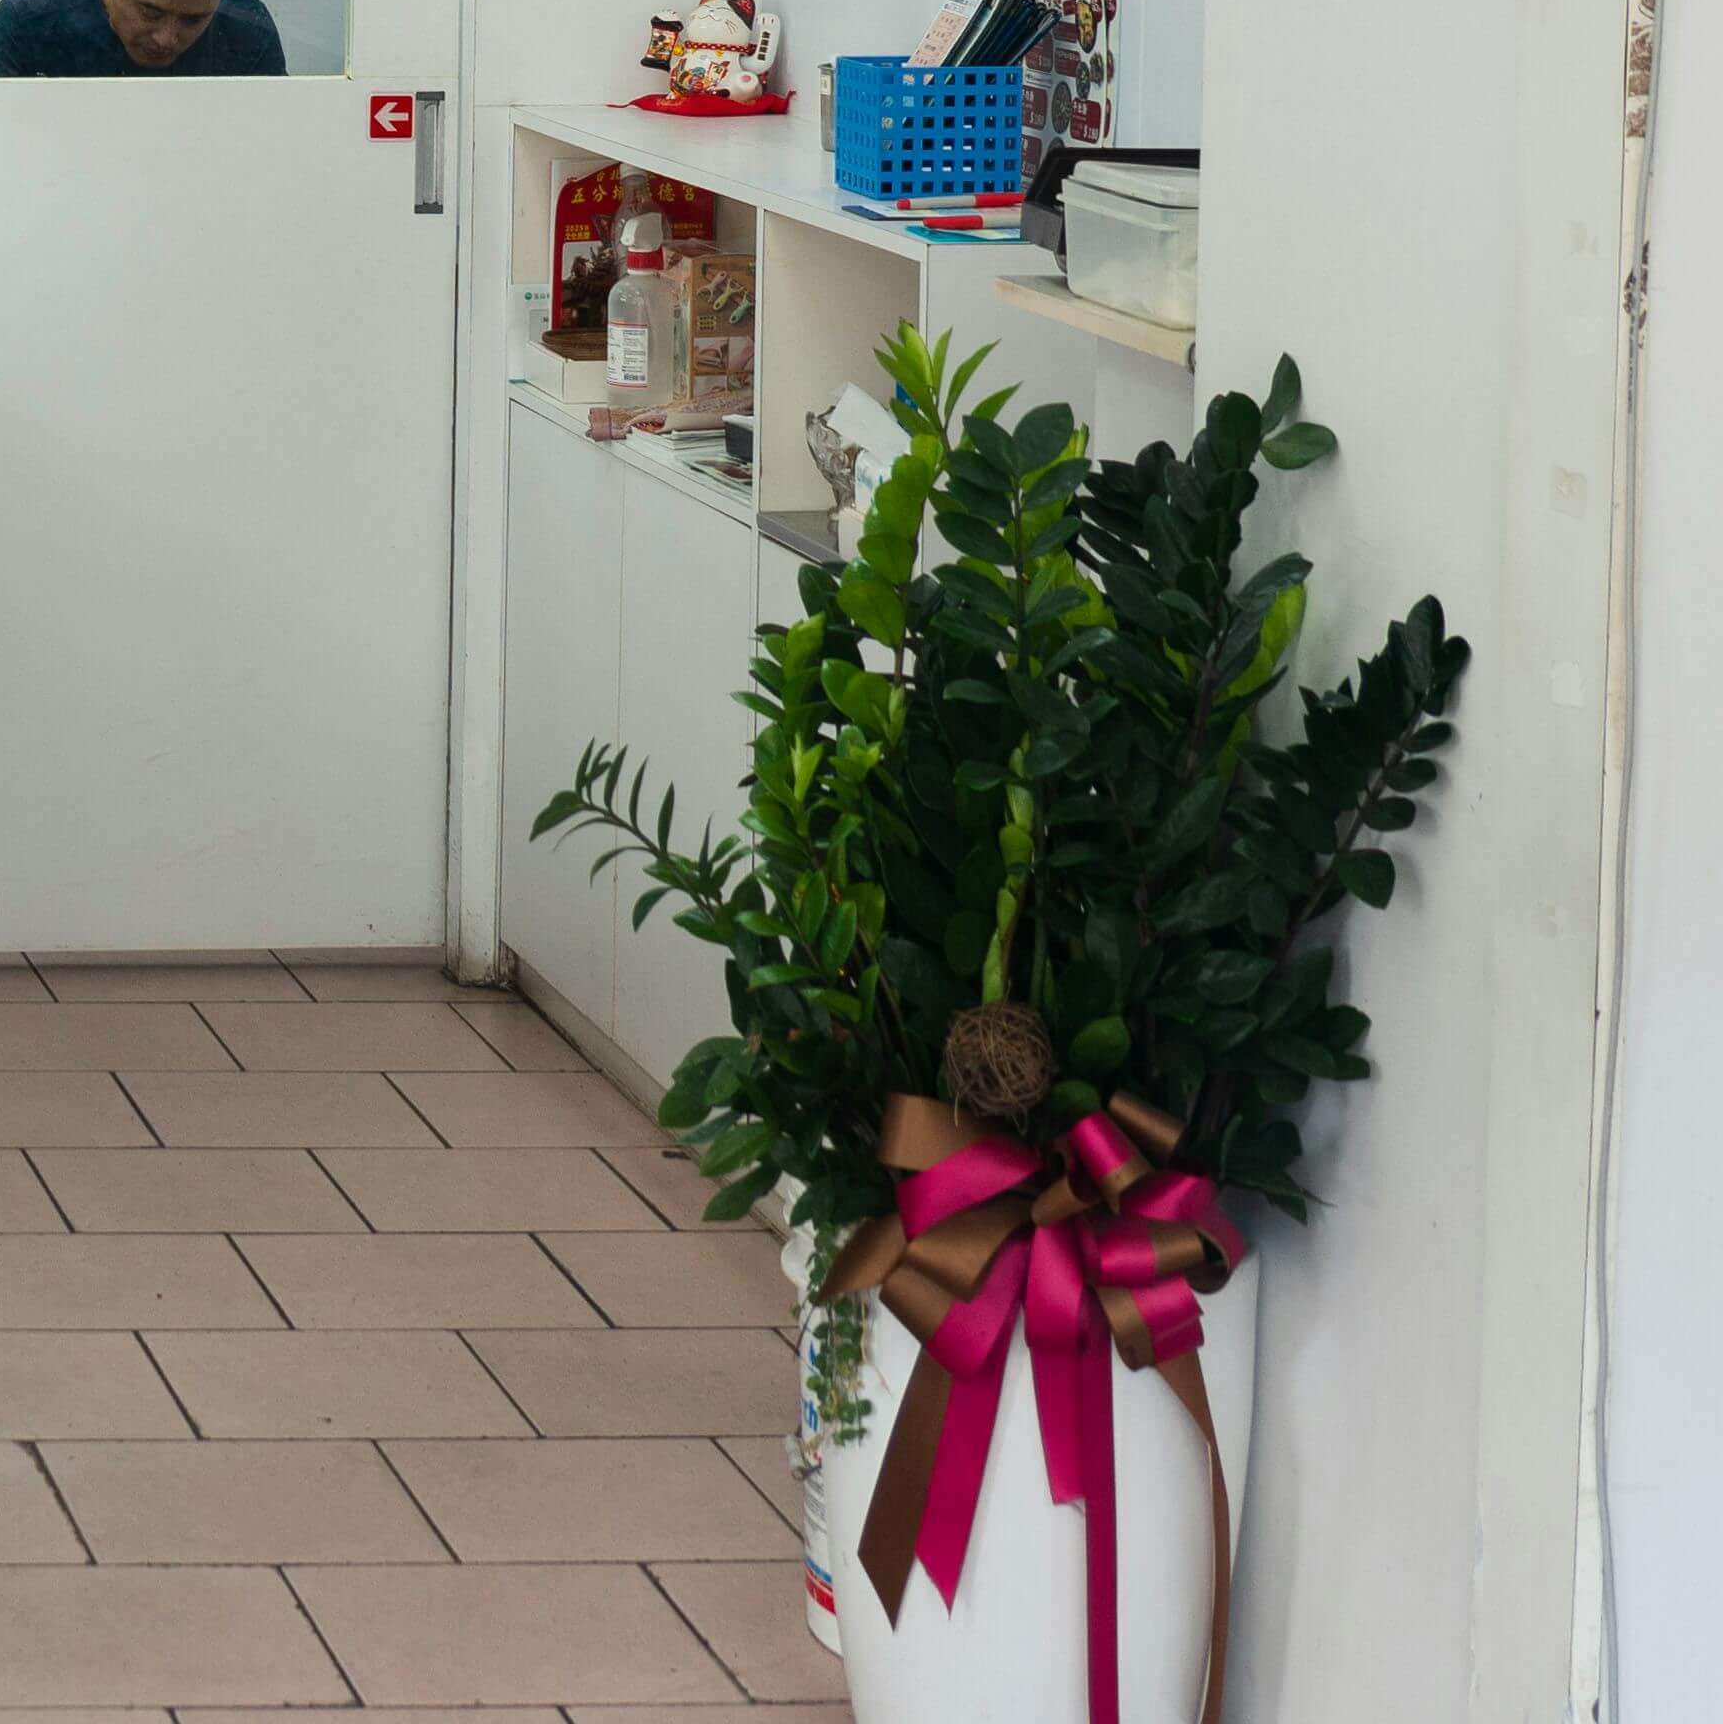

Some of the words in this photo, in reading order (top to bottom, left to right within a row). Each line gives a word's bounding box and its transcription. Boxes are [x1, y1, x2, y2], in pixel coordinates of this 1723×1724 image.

[570, 182, 696, 204] 五分埔德宮
